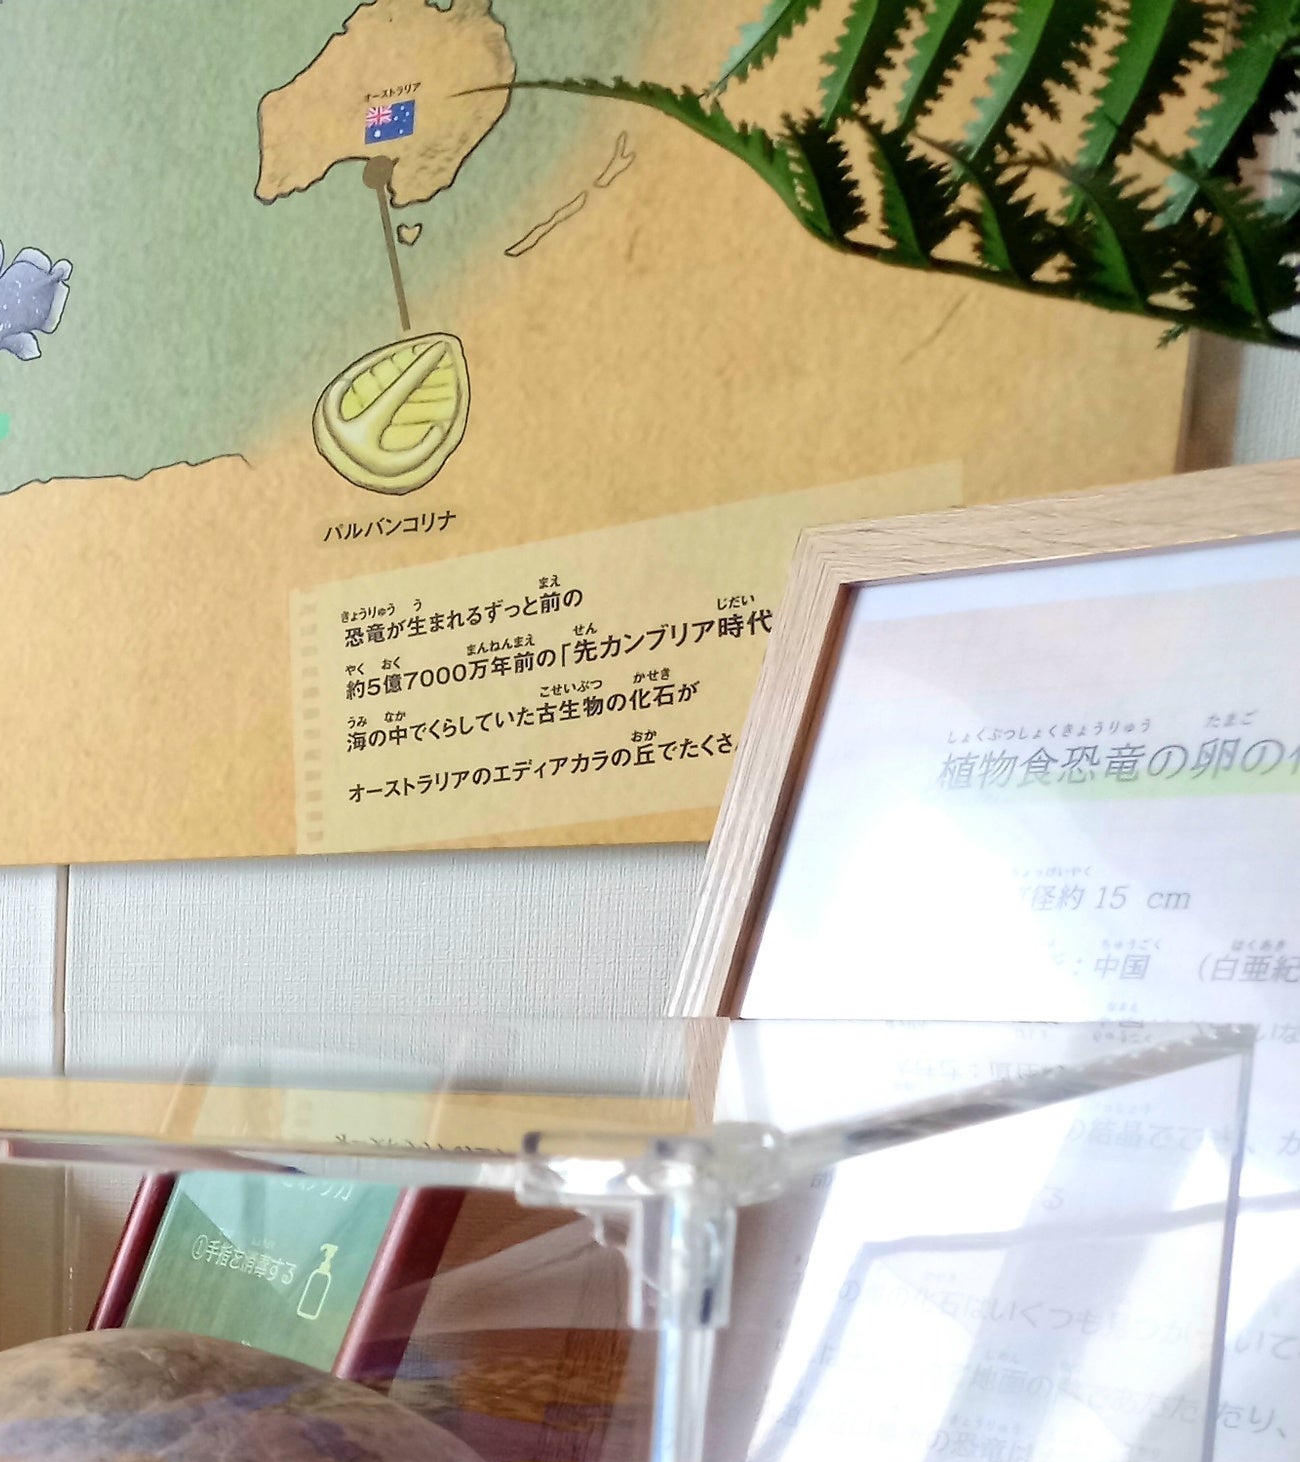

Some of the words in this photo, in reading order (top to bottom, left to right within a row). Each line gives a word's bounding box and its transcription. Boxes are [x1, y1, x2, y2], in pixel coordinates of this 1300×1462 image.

[323, 510, 457, 544] パルバンコリナ
[344, 588, 583, 648] 恐竜が生まれるずっと前の
[346, 681, 700, 752] 海の中でくらしていた古生物の化石が
[348, 732, 738, 804] オーストラリアのエディアカラの丘でたくさ
[1095, 885, 1128, 910] 15
[1147, 889, 1191, 910] cm
